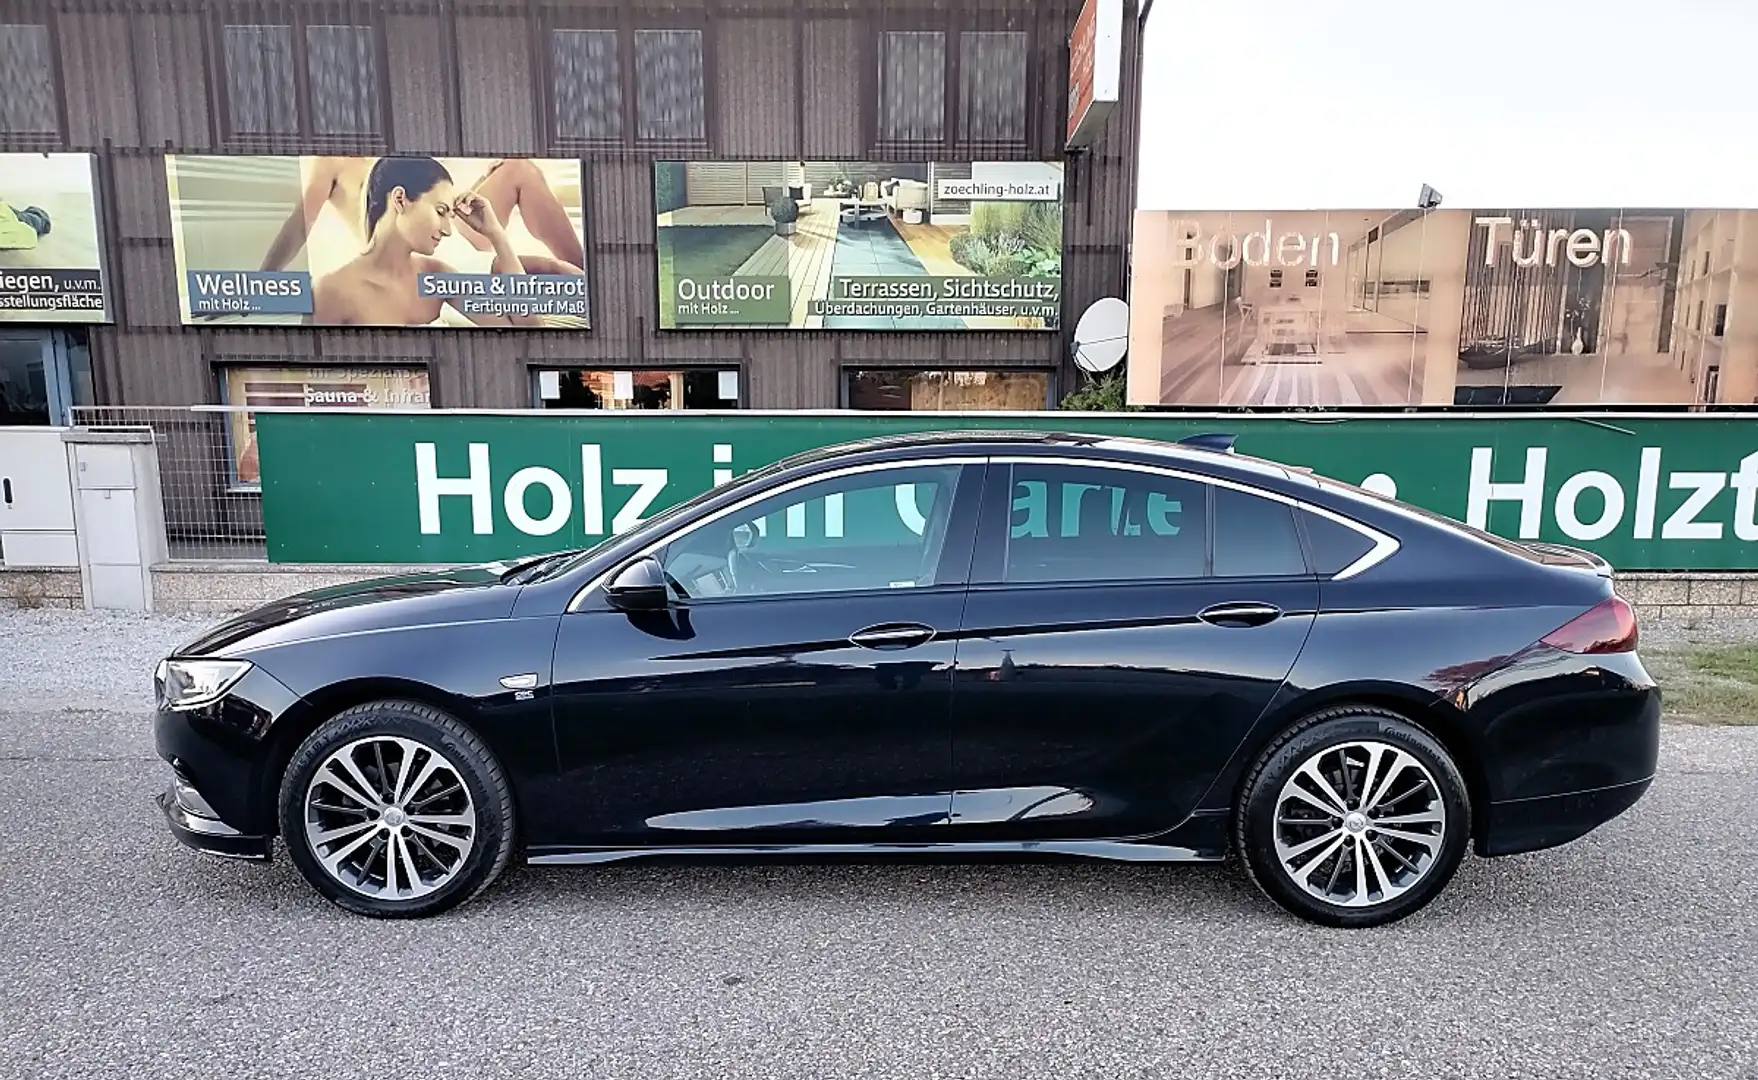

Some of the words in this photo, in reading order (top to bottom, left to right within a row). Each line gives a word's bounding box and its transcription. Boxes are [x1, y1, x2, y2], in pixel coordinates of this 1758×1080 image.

[943, 182, 1050, 198] zoechling-holz.at
[1475, 216, 1635, 268] Türen
[64, 279, 101, 290] u.v.m.
[195, 272, 302, 296] Wellness
[423, 275, 486, 295] Sauna
[489, 276, 506, 295] &
[510, 276, 585, 296] Infrarot
[678, 278, 775, 300] Outdoor
[839, 278, 938, 300] Terrassen,
[942, 278, 1059, 302] Sichtschutz,
[199, 298, 220, 310] mit
[464, 300, 529, 316] Fertigung
[532, 300, 554, 313] auf
[556, 300, 585, 313] Maß
[678, 302, 699, 315] mit
[815, 299, 923, 319] Überdachungen,
[926, 302, 1017, 317] Gartenhäuser,
[1021, 305, 1058, 317] u.v.m.
[306, 387, 358, 403] Sauna
[363, 387, 379, 403] &
[415, 442, 668, 536] Holz
